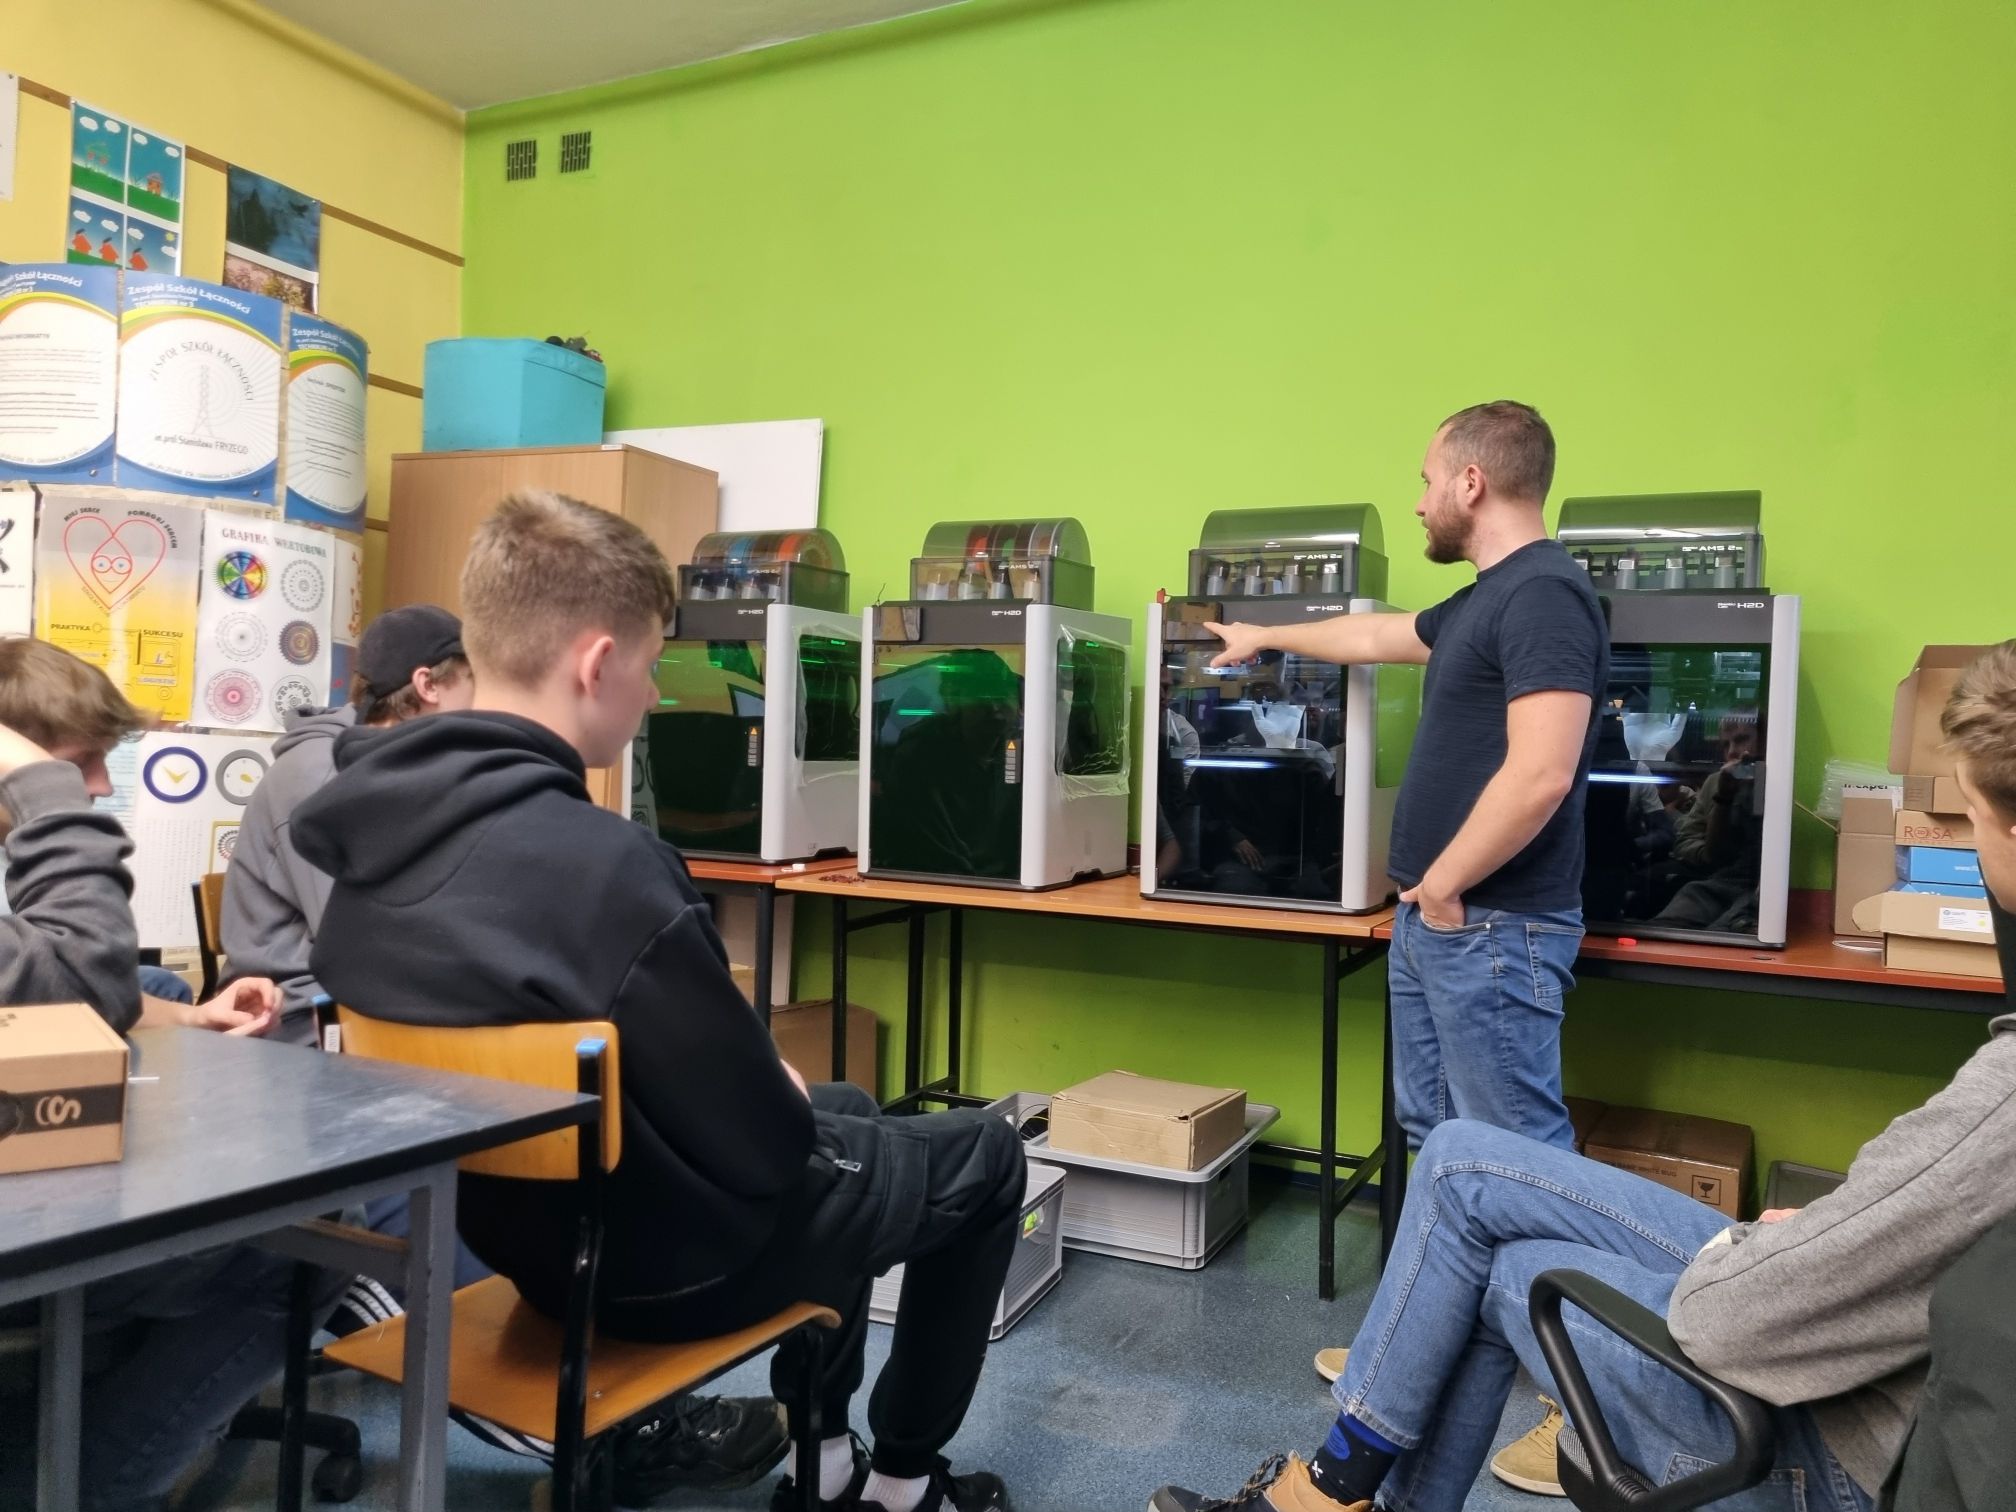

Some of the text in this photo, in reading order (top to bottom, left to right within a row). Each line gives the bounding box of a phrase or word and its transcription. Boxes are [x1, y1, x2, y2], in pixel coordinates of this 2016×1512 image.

[127, 283, 165, 295] Zespół
[166, 283, 197, 295] Szkół
[199, 289, 252, 315] Łączności
[221, 527, 269, 546] GRAFIKA
[51, 623, 91, 632] PRAKTYKA
[143, 629, 183, 638] SUKCESU
